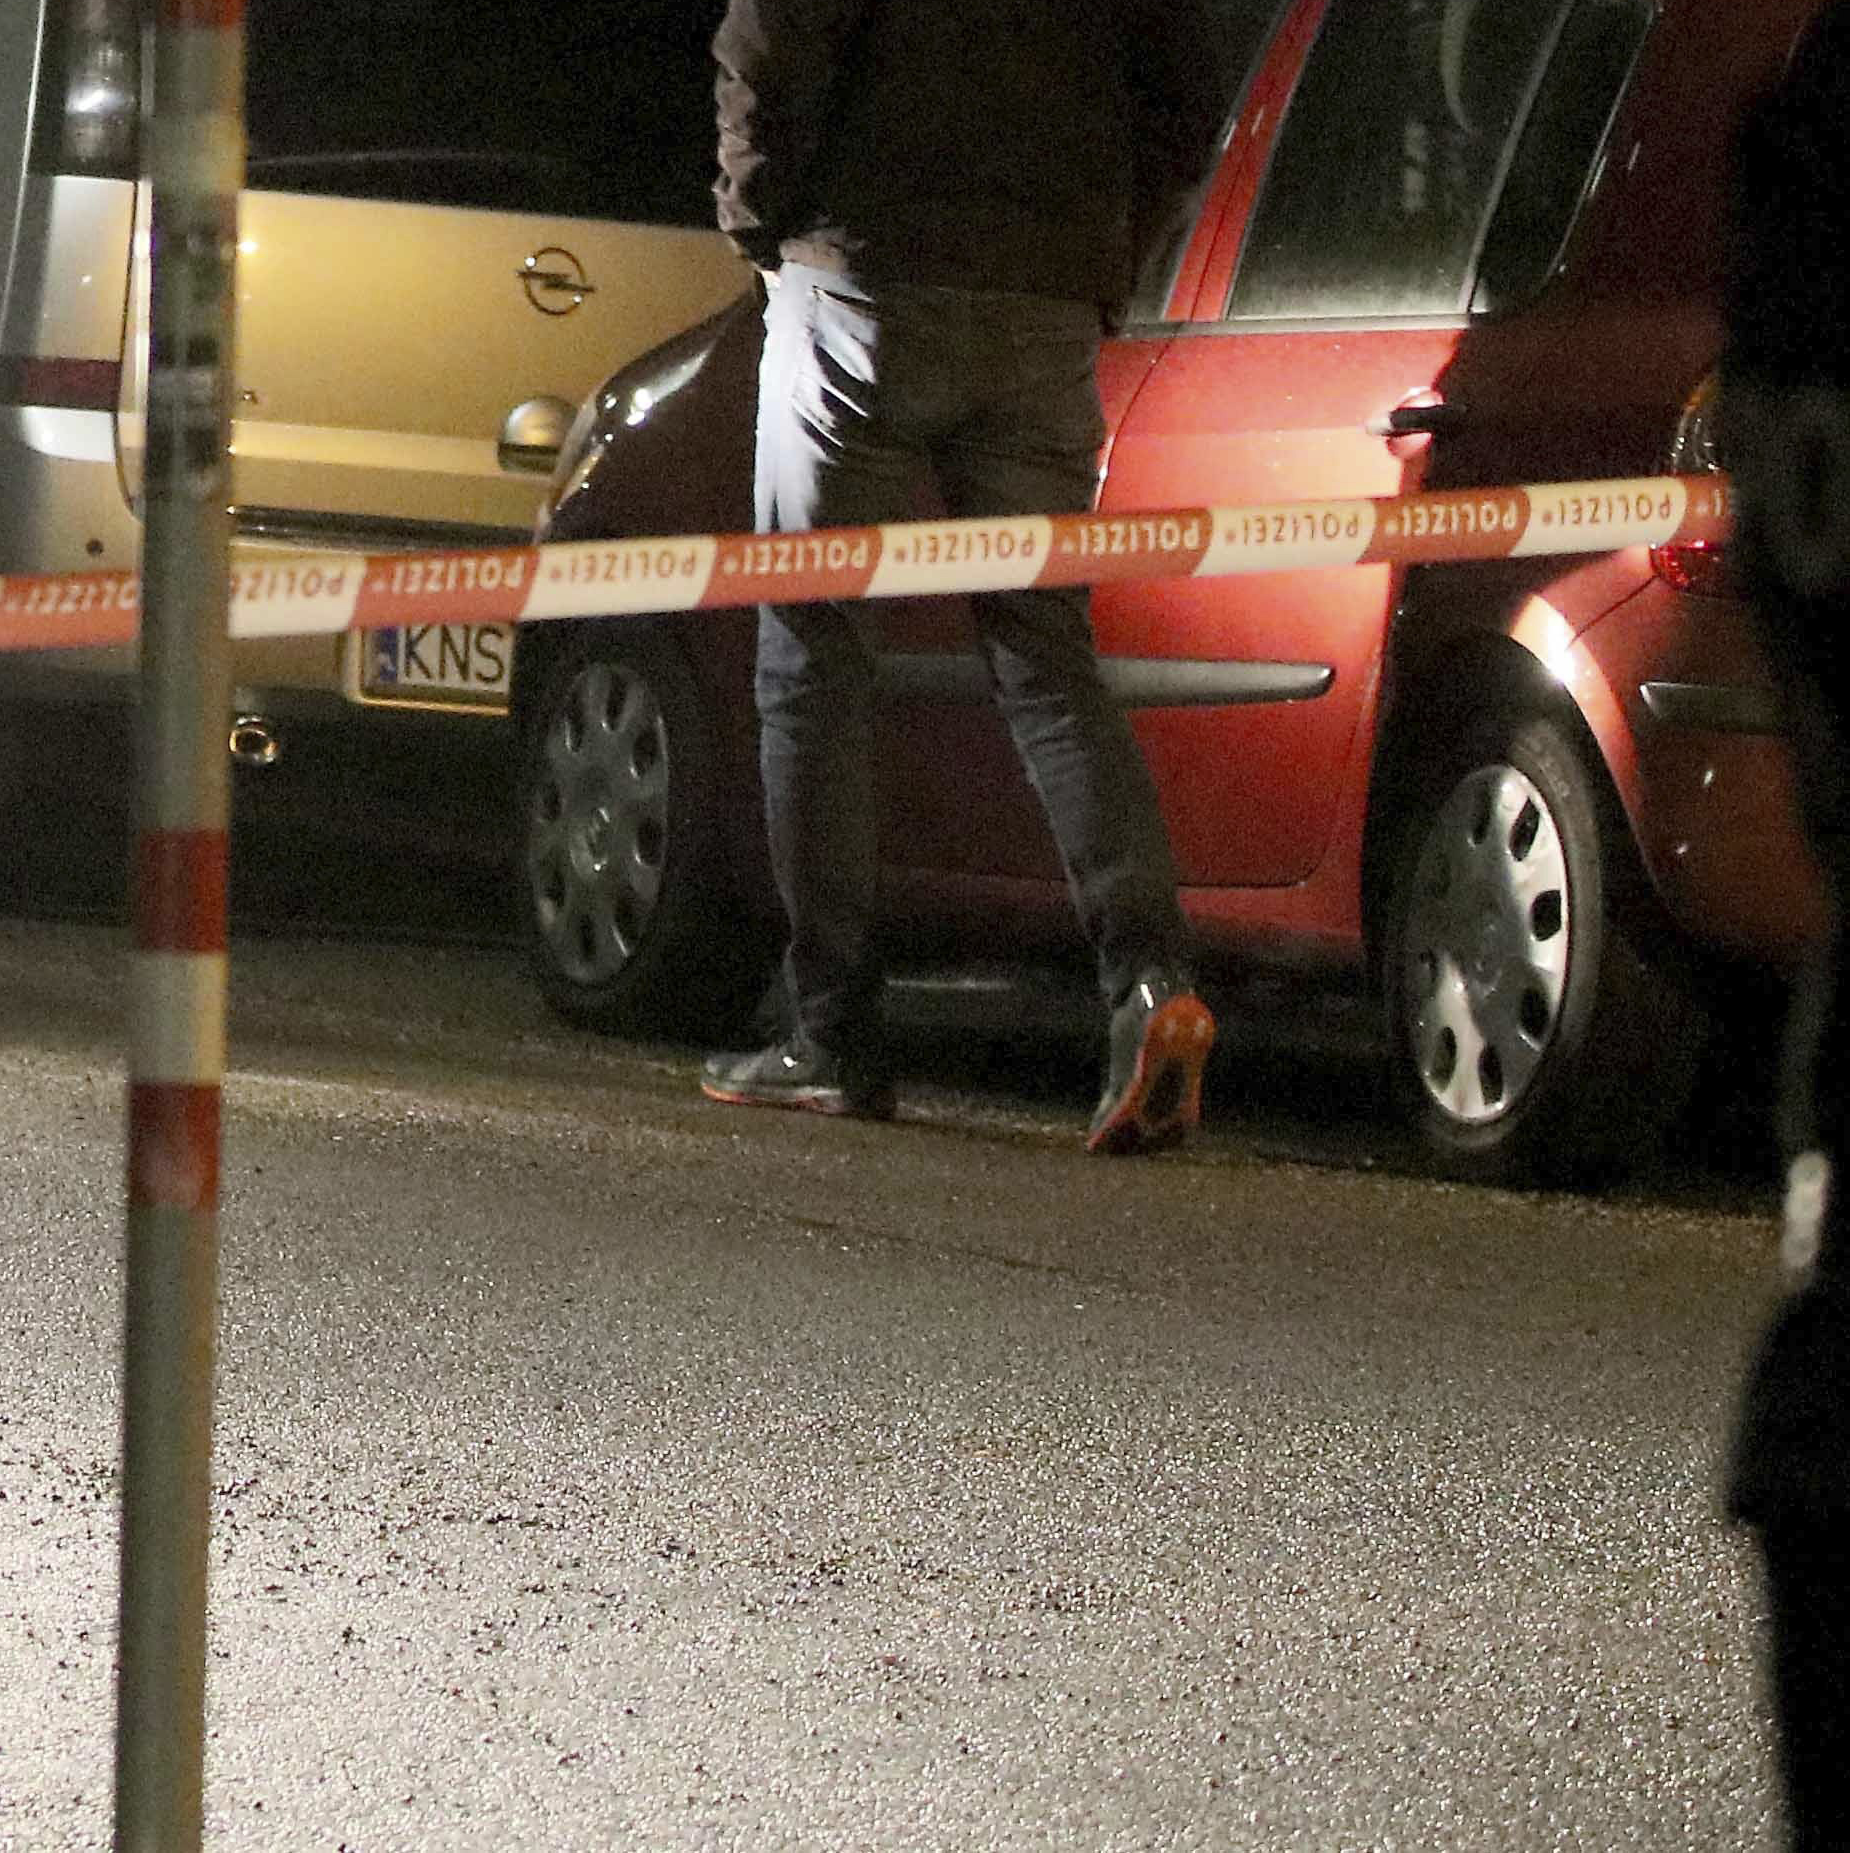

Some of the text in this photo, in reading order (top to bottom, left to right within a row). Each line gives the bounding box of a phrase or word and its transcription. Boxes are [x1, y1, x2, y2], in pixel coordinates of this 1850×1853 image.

[390, 554, 527, 595] POLIZEI
[567, 542, 698, 583] POLIZEI
[741, 536, 870, 577] POLIZEI
[912, 527, 1036, 565] POLIZEI
[1077, 517, 1202, 558] POLIZEI
[1241, 512, 1361, 546] POLIZEI
[1401, 500, 1518, 537] POLIZEI
[1556, 492, 1673, 526] POLIZEI
[403, 623, 504, 684] KNS
